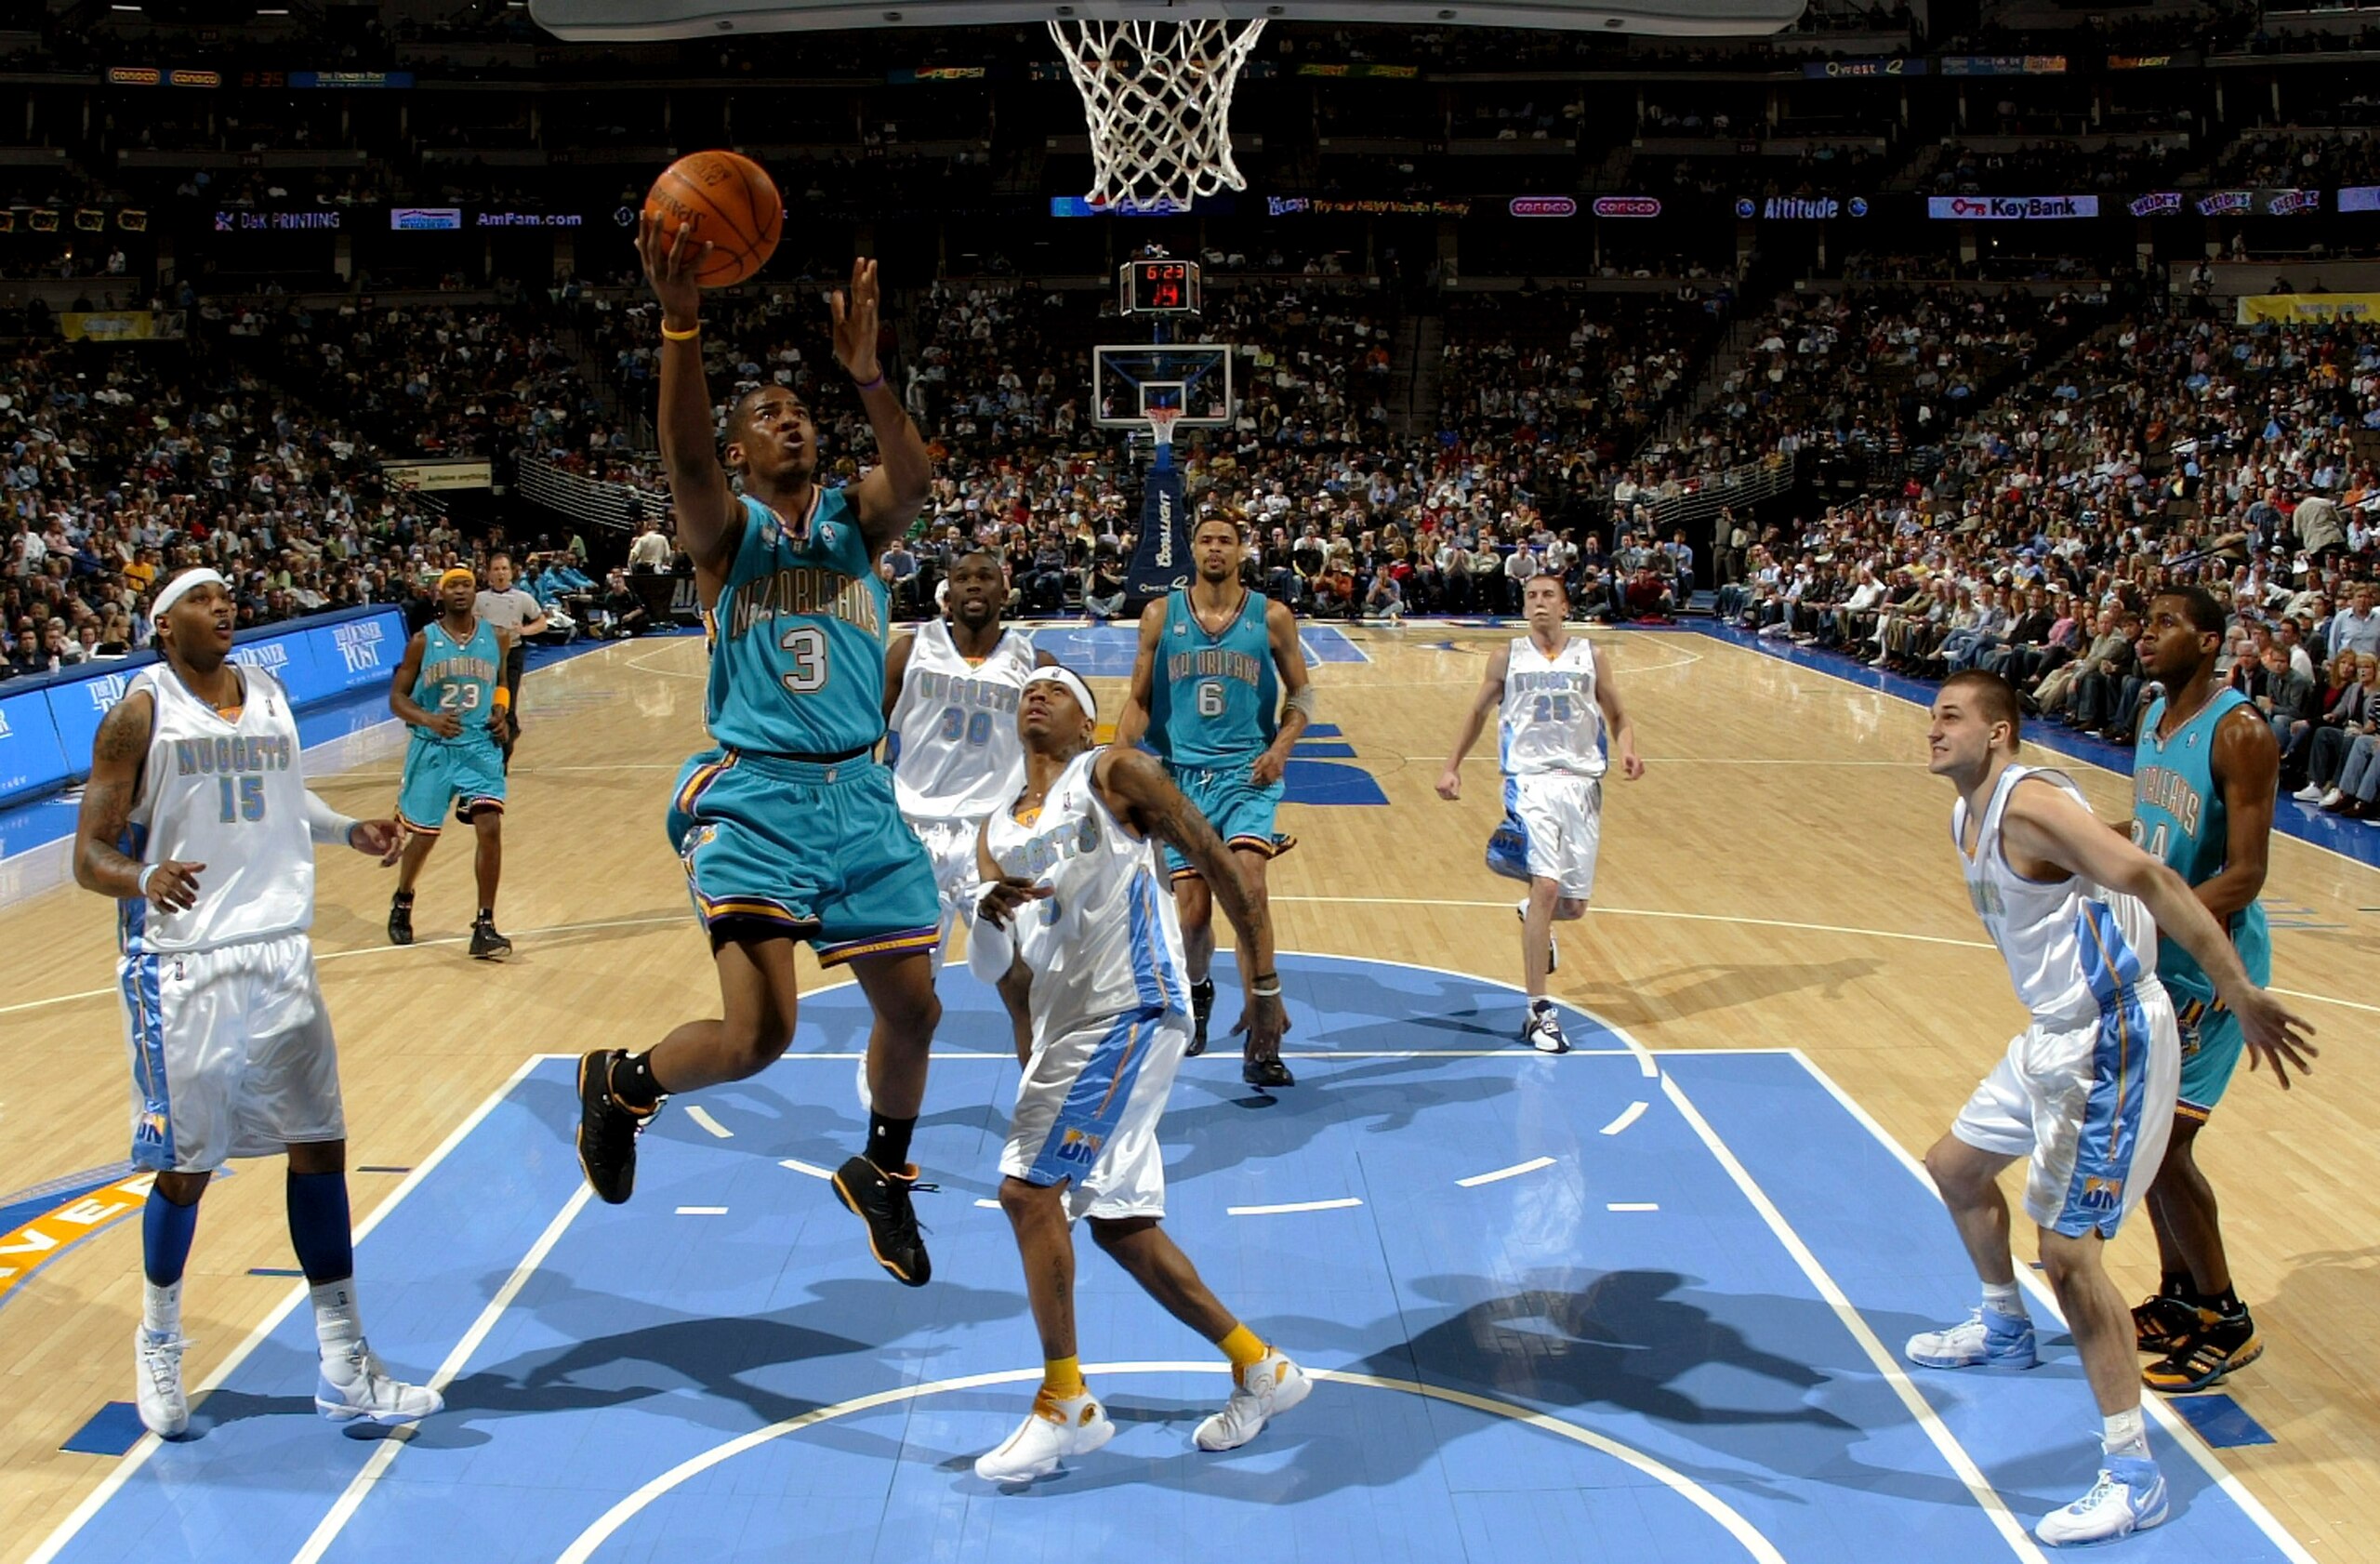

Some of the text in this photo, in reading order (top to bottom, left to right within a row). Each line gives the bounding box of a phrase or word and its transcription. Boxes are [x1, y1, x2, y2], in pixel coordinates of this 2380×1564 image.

[271, 211, 340, 230] PRINTING
[1763, 196, 1840, 219] Altitude
[1991, 198, 2076, 219] KeyBank
[1146, 265, 1184, 280] 6:23
[777, 568, 880, 640] ORLEANS
[343, 622, 383, 643] DENVER
[337, 639, 385, 673] POST
[780, 626, 828, 694] 3
[440, 683, 481, 709] 23
[919, 671, 1021, 713] NUGGETS
[1197, 682, 1224, 718] 6
[1533, 695, 1571, 722] 25
[941, 707, 994, 747] 30
[174, 735, 290, 775] NUGGETS
[218, 775, 267, 823] 15
